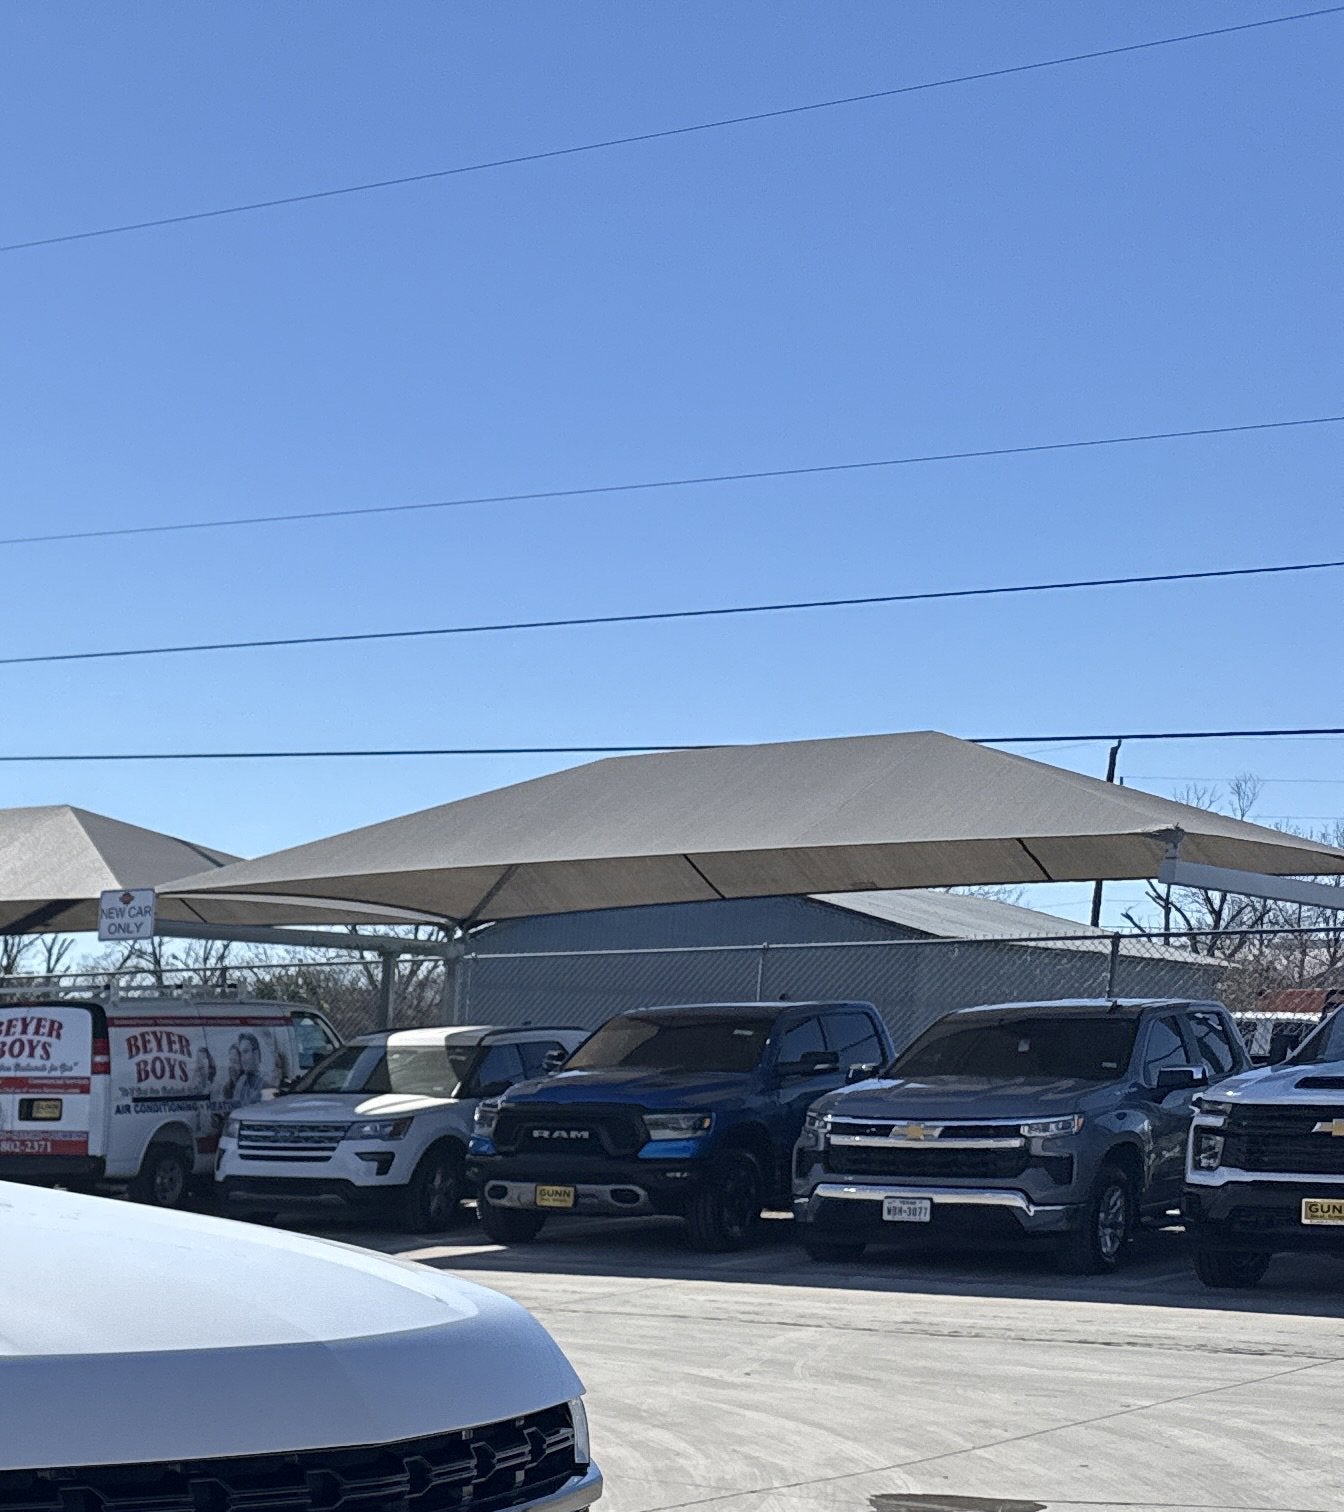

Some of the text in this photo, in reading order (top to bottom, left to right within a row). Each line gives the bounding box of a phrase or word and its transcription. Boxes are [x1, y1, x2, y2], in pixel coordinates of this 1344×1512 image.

[101, 905, 152, 920] NEW CAR
[107, 922, 144, 935] ONLY
[125, 1030, 193, 1060] BEYER
[135, 1056, 190, 1084] BOYS
[114, 1104, 132, 1115] AIR
[532, 1129, 590, 1139] RAM
[538, 1188, 571, 1198] GUNN
[1308, 1203, 1344, 1215] GUN
